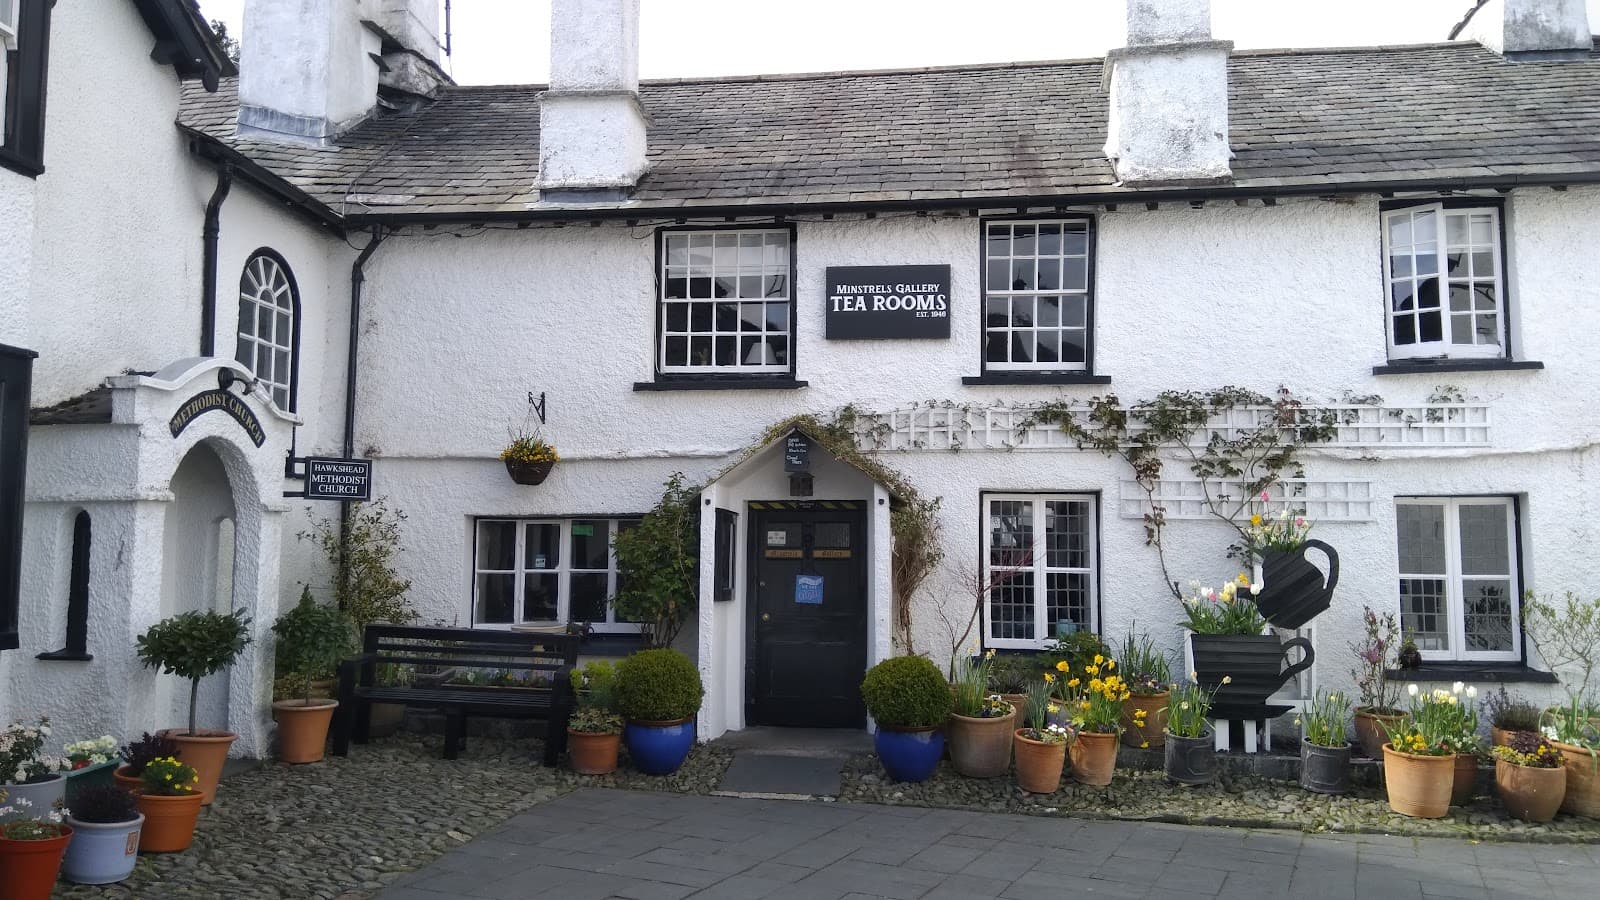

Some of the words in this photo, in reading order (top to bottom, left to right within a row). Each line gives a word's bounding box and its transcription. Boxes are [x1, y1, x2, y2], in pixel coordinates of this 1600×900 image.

[836, 284, 892, 294] MINSTRELS
[895, 283, 940, 294] GALLERY
[830, 295, 867, 312] TEA
[872, 294, 947, 311] ROOMS
[172, 393, 227, 432] METHODIST
[229, 398, 263, 443] CHURCH
[314, 463, 365, 474] HAWKSHEAD
[311, 474, 367, 485] METHODIST
[318, 484, 358, 494] CHURCH
